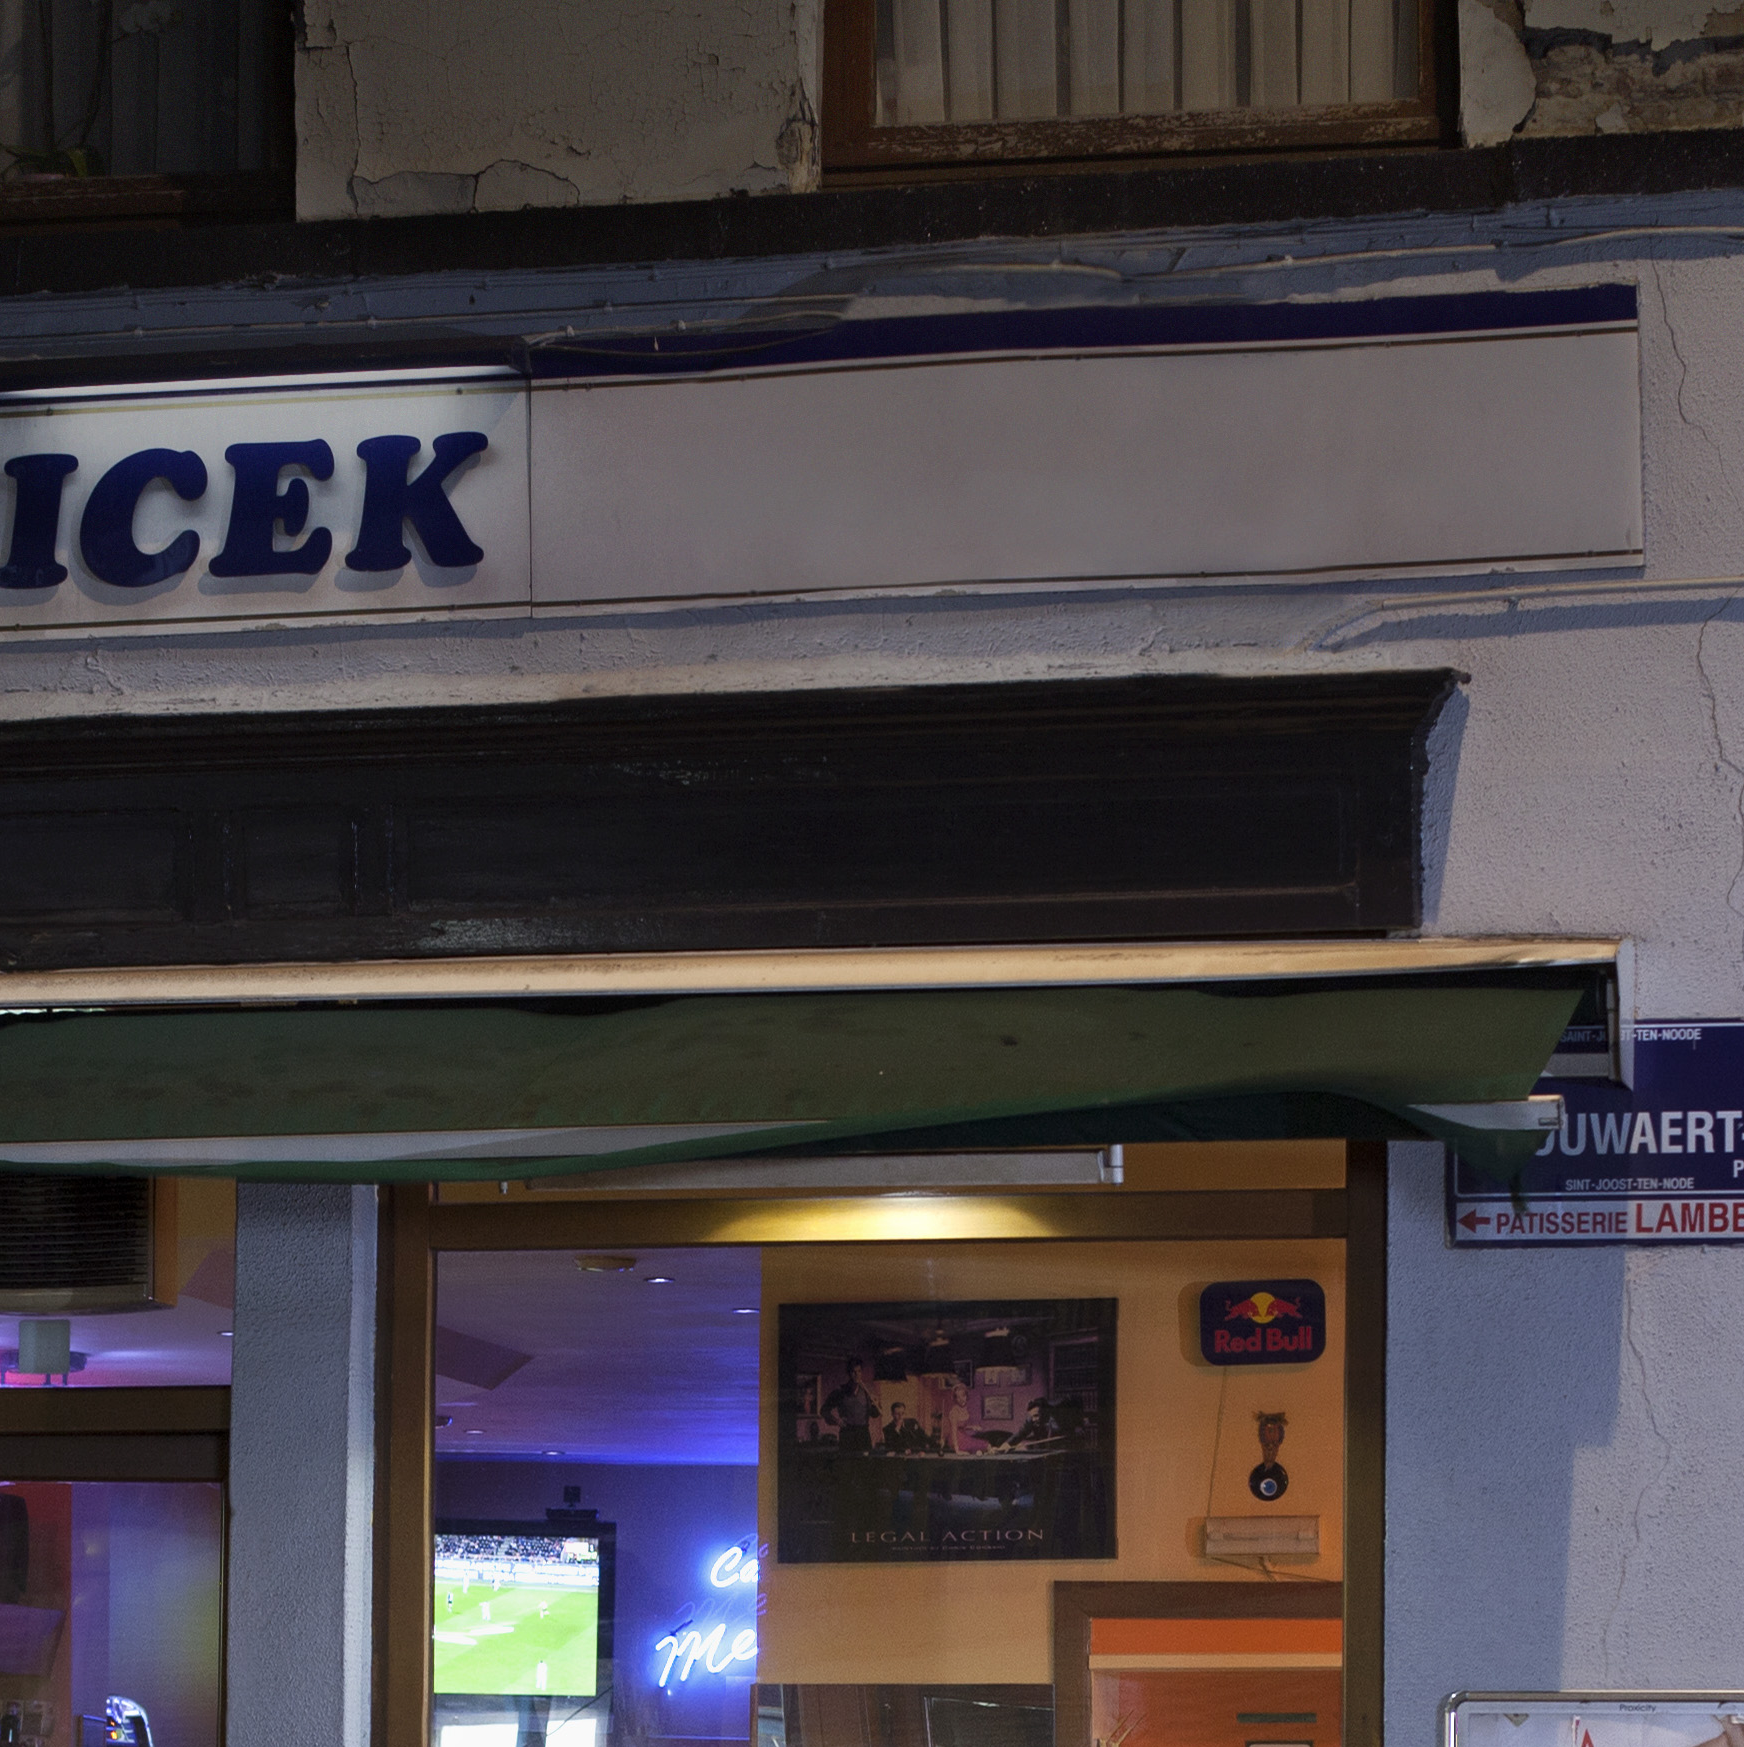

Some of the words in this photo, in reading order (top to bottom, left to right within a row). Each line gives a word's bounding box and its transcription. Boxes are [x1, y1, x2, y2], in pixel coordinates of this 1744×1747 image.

[1565, 1177, 1695, 1191] SINT-JOOST-TEN-NODE
[1496, 1211, 1628, 1235] PATISSERIE
[1215, 1328, 1262, 1353] Red
[1266, 1326, 1312, 1351] Bull
[851, 1530, 931, 1543] LEGAL
[942, 1528, 1044, 1542] ACTION
[710, 1546, 759, 1588] Ca
[656, 1623, 758, 1688] Me
